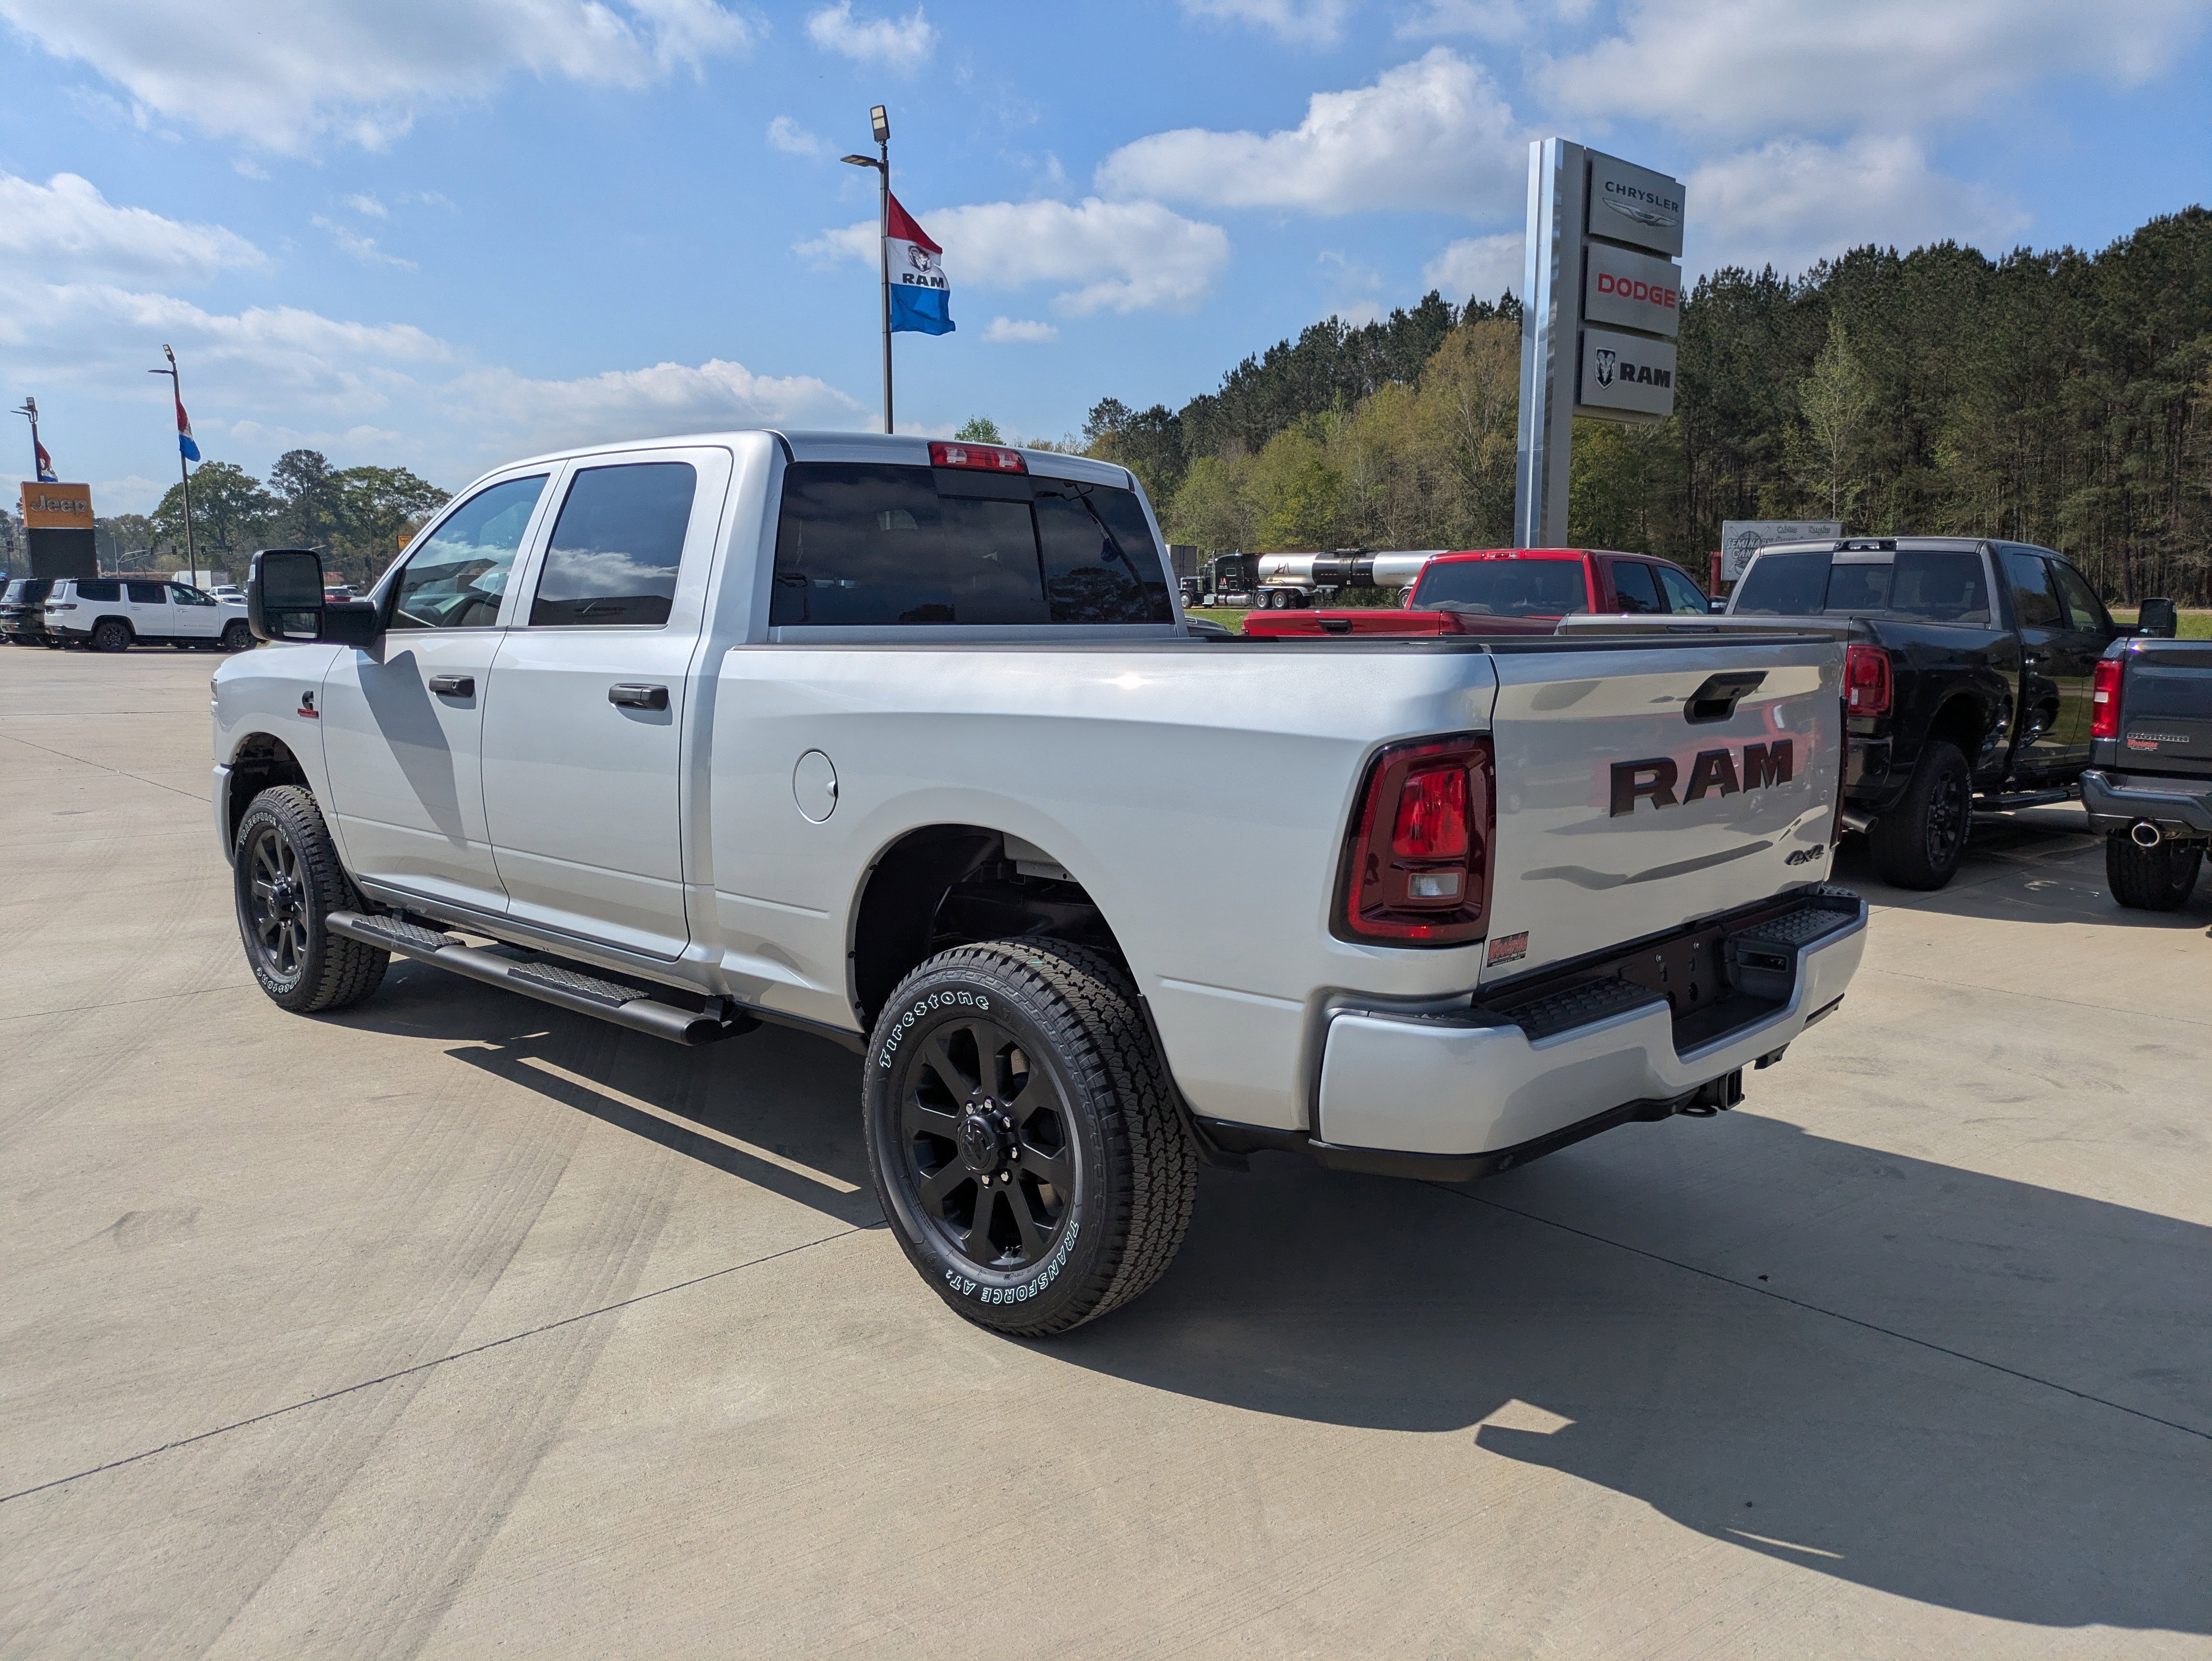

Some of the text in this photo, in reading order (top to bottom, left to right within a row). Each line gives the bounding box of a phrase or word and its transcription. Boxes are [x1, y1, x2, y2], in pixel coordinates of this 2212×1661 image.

[1604, 181, 1679, 213] CHRYSLER
[901, 273, 945, 288] RAM
[1598, 273, 1676, 309] DODGE
[1620, 362, 1671, 388] RAM
[30, 495, 88, 515] Jeep
[1609, 738, 1793, 819] RAM
[239, 812, 276, 845] TRANSFORCE
[879, 991, 989, 1068] Firestone
[981, 1220, 1080, 1305] TRANSFORCE
